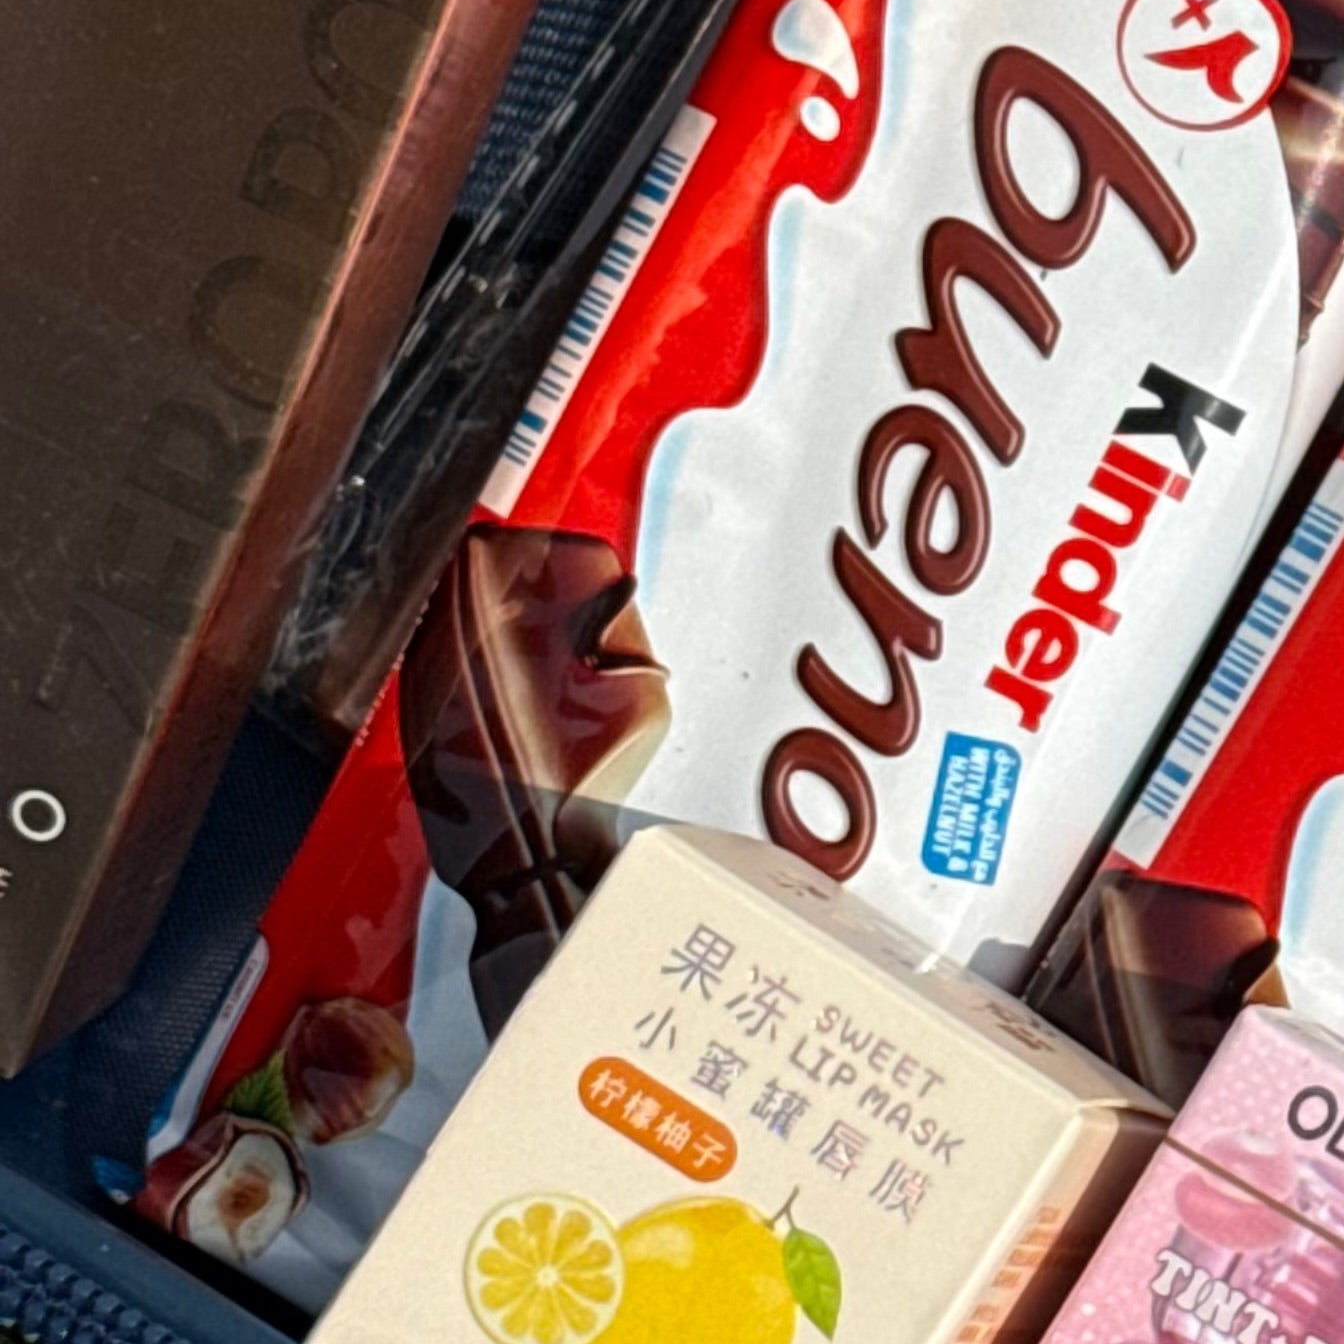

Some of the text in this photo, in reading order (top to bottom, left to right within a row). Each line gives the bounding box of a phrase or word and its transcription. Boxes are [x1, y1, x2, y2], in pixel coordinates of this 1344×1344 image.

[761, 45, 1196, 881] bueno
[983, 362, 1246, 733] Kinder
[929, 753, 970, 857] HAZELNUT
[951, 801, 980, 854] MILK
[962, 745, 991, 799] WITH
[660, 922, 804, 1043] 果冻
[788, 1039, 966, 1167] LIP MASK
[814, 1004, 945, 1099] SWEET
[588, 1067, 727, 1172] 柠檬柚子
[633, 1005, 936, 1226] 小蜜罐唇膜
